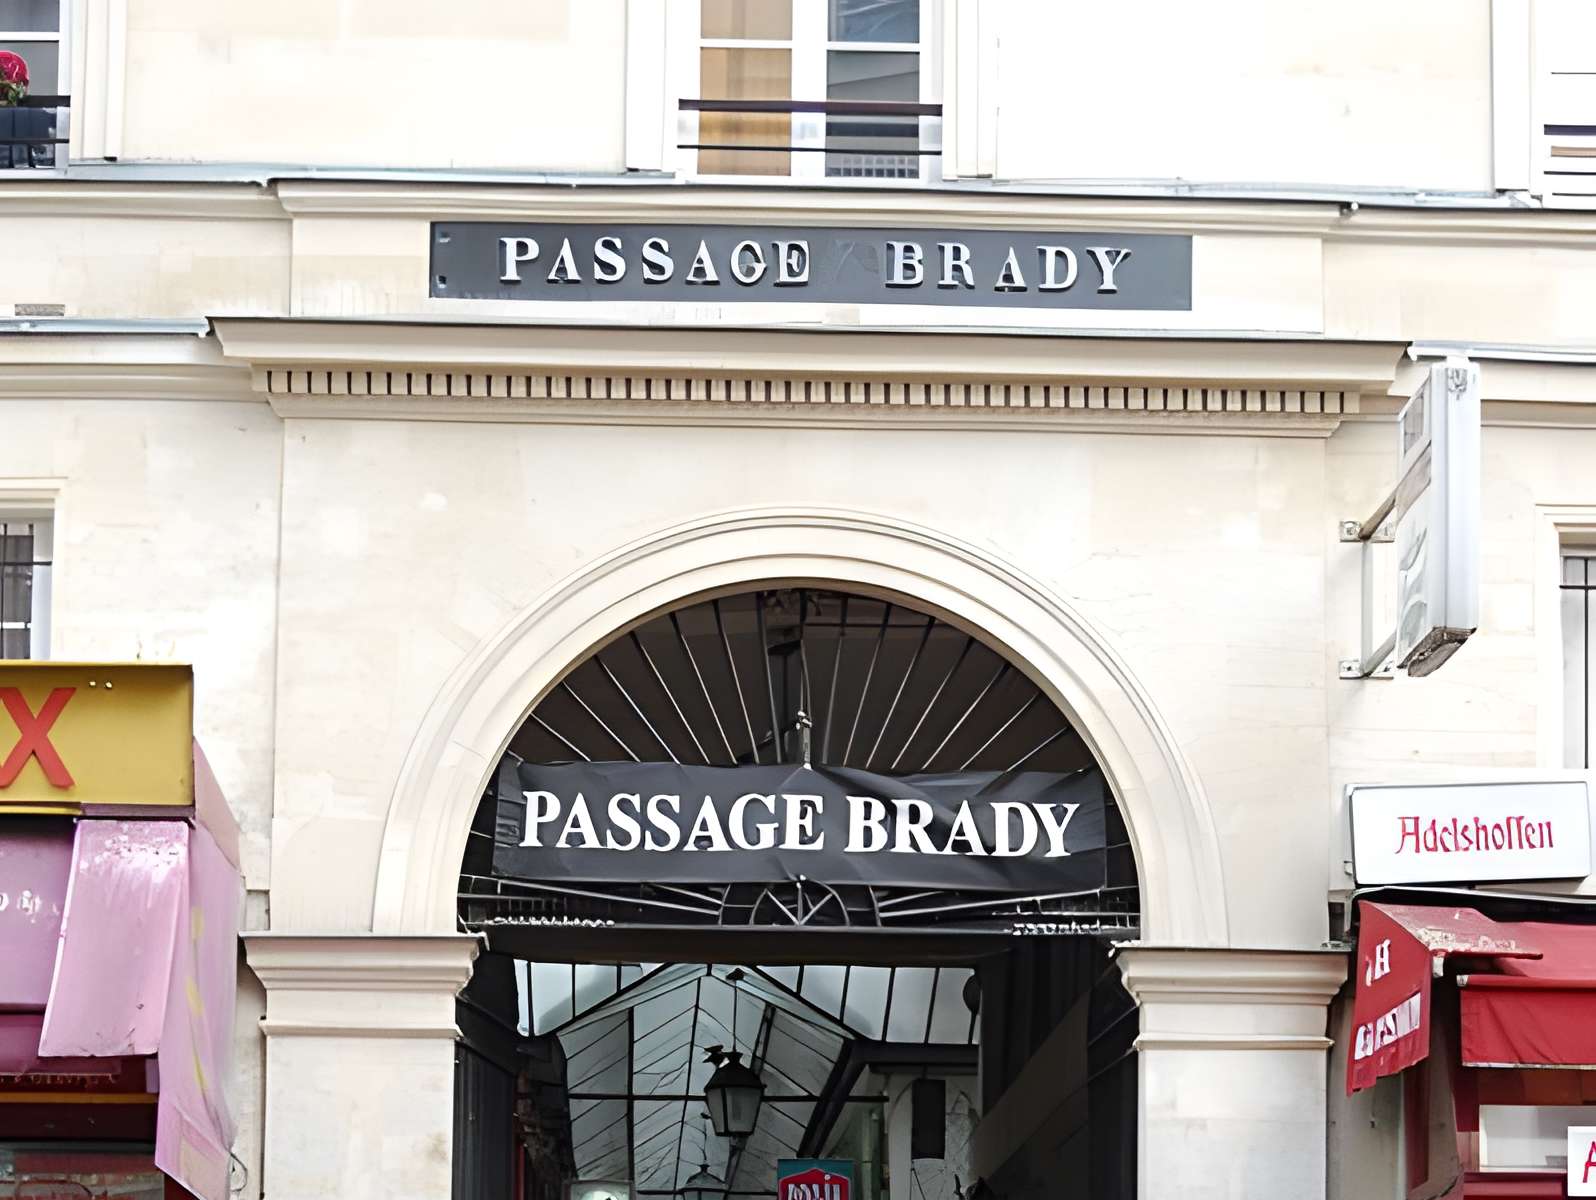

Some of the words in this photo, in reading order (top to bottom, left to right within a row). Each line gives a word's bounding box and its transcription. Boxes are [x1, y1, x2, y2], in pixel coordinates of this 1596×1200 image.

[499, 236, 810, 288] PASSAGE
[885, 240, 1132, 295] BRADY
[520, 790, 825, 852] PASSAGE
[844, 795, 1081, 859] BRADY
